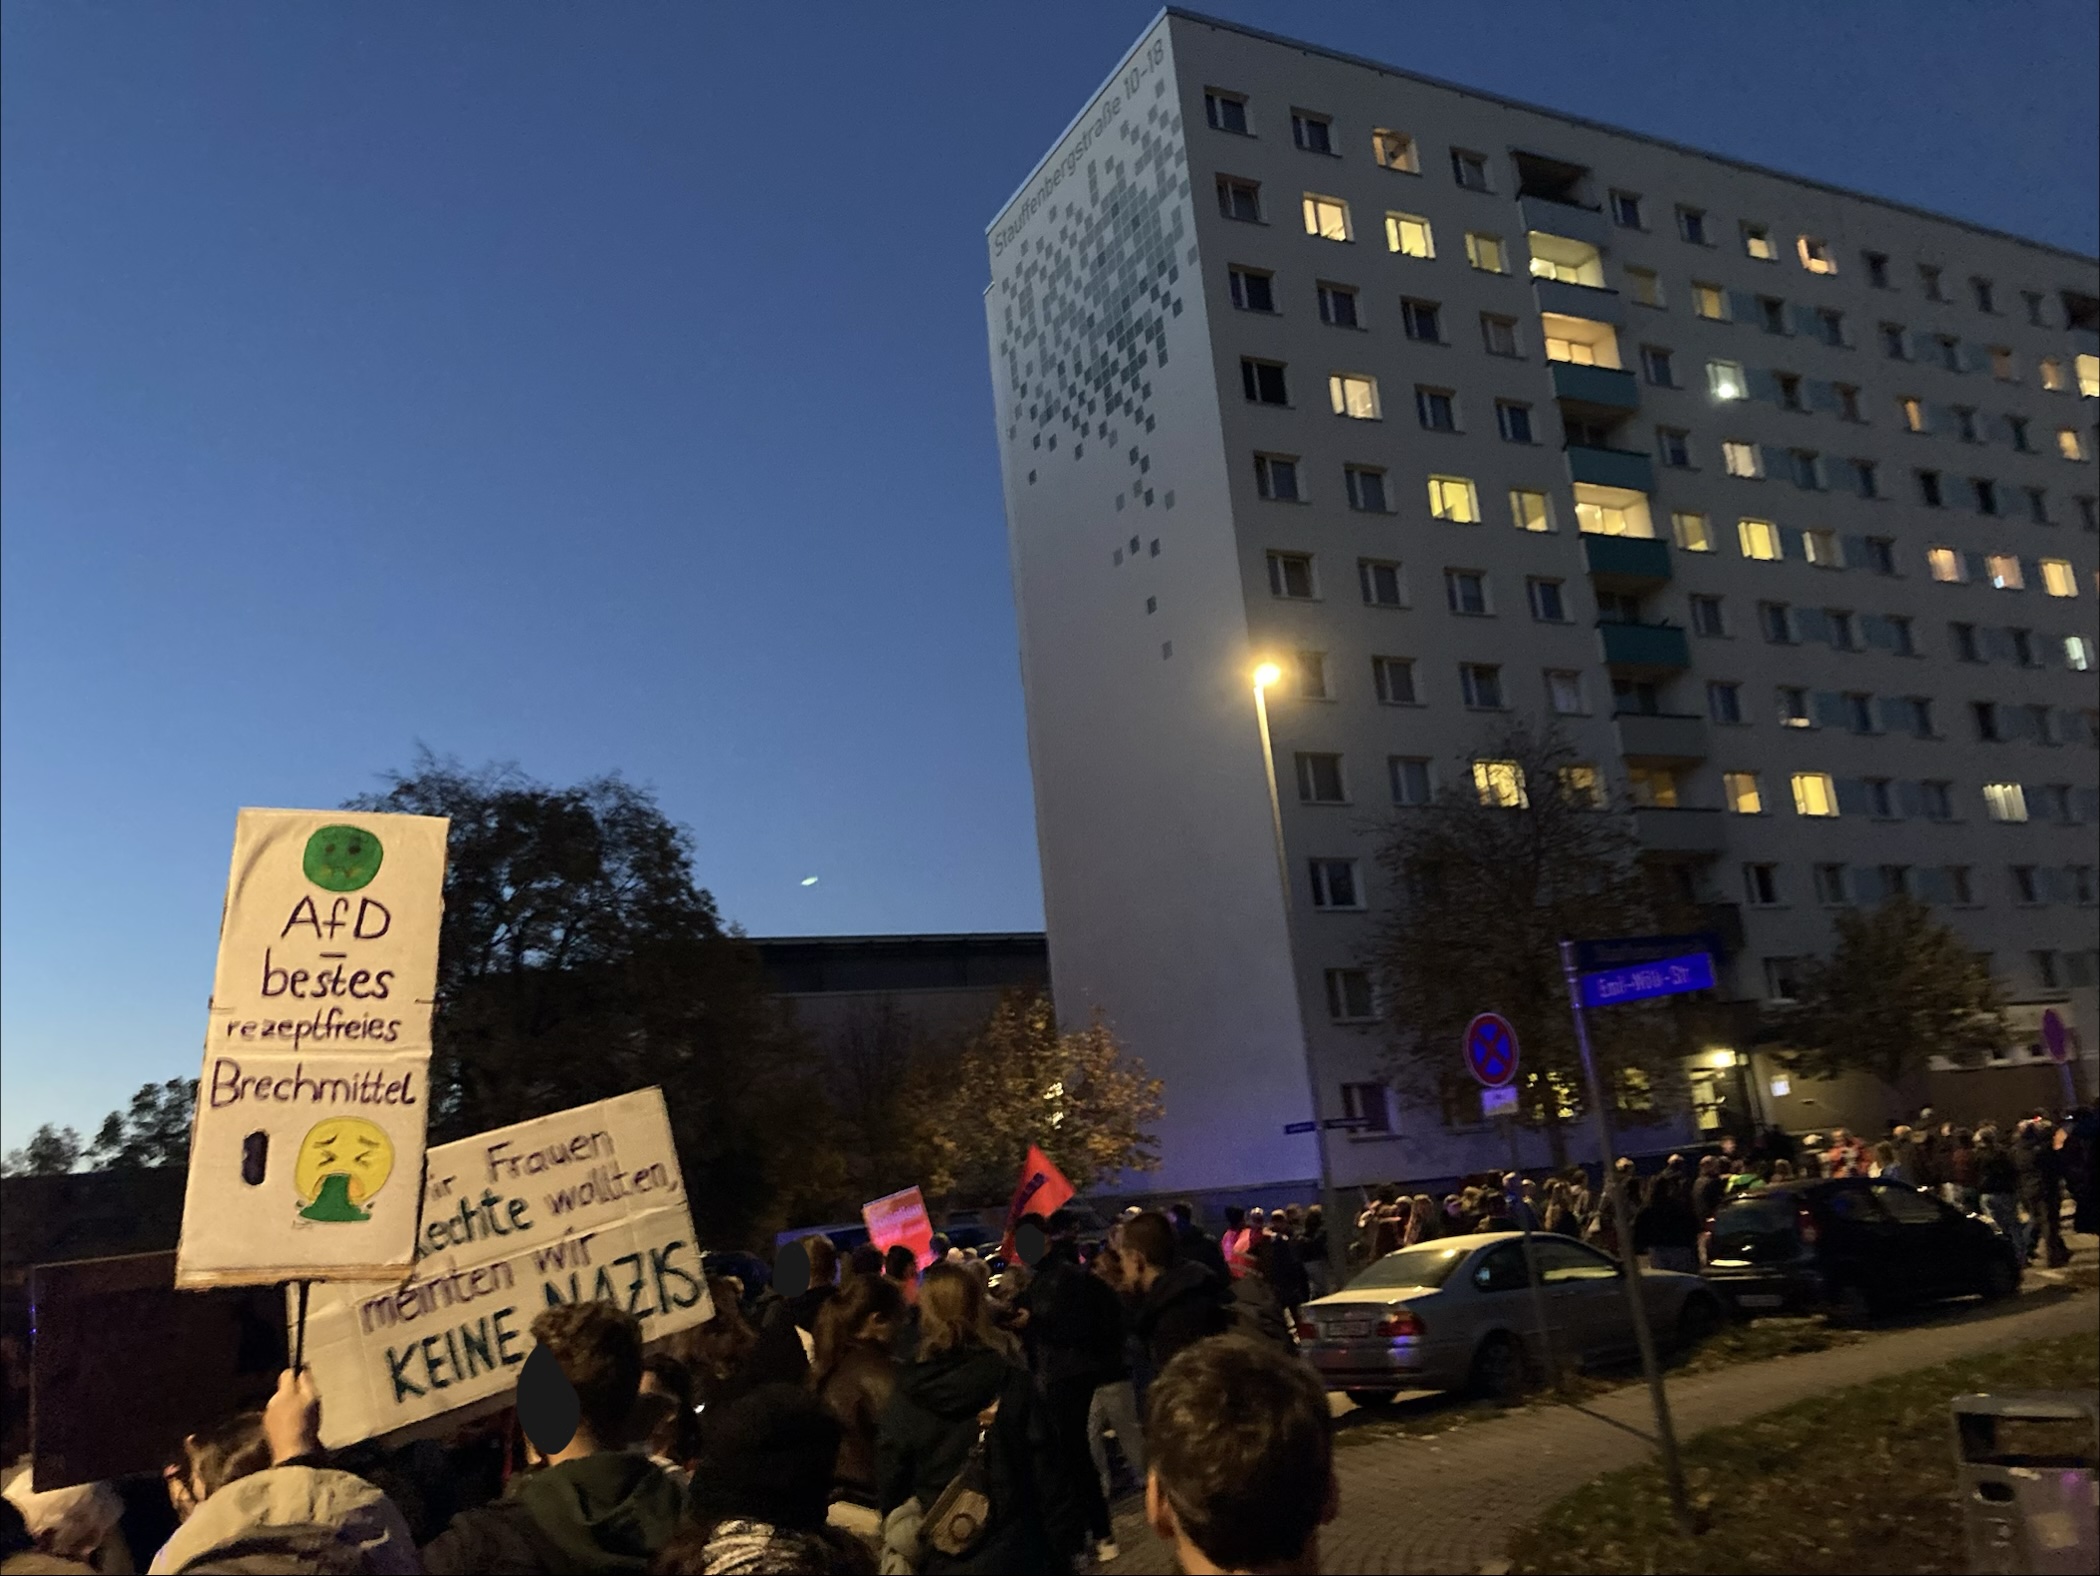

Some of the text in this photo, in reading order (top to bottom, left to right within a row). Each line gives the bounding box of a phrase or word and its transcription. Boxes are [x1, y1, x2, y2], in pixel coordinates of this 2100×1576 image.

[994, 95, 1122, 257] Stauffenbergstraße
[281, 895, 392, 940] AfD
[261, 946, 395, 1000] bestes
[226, 1004, 403, 1052] rezeptfreies
[210, 1056, 417, 1109] Brechmittel
[427, 1129, 617, 1201] ir Frauen
[544, 1161, 679, 1217] wollten,
[359, 1226, 600, 1336] meinten wir
[384, 1304, 529, 1404] KEINE
